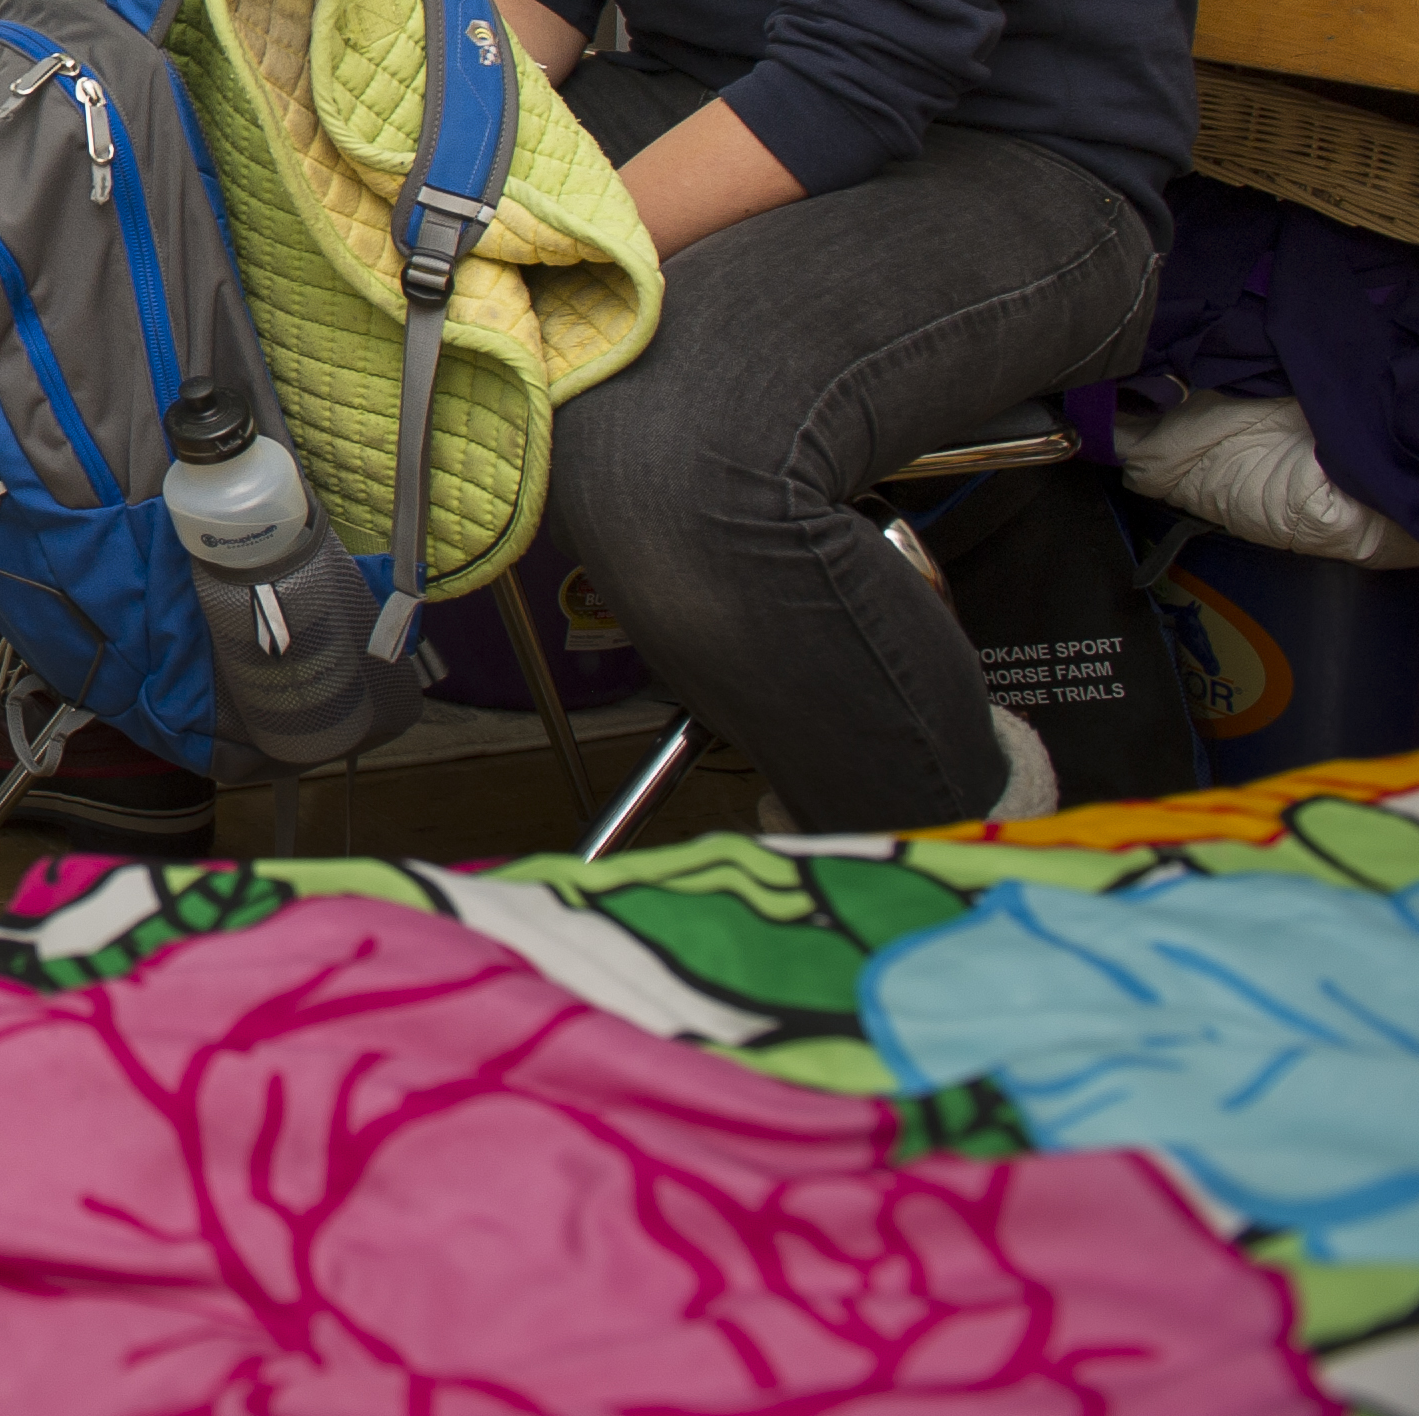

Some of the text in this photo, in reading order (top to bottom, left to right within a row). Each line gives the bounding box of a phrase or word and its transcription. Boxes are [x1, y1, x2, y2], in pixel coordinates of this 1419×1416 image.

[980, 637, 1123, 664] OKANE SPORT
[983, 661, 1113, 685] HORSE FARM
[1052, 683, 1125, 703] TRIALS
